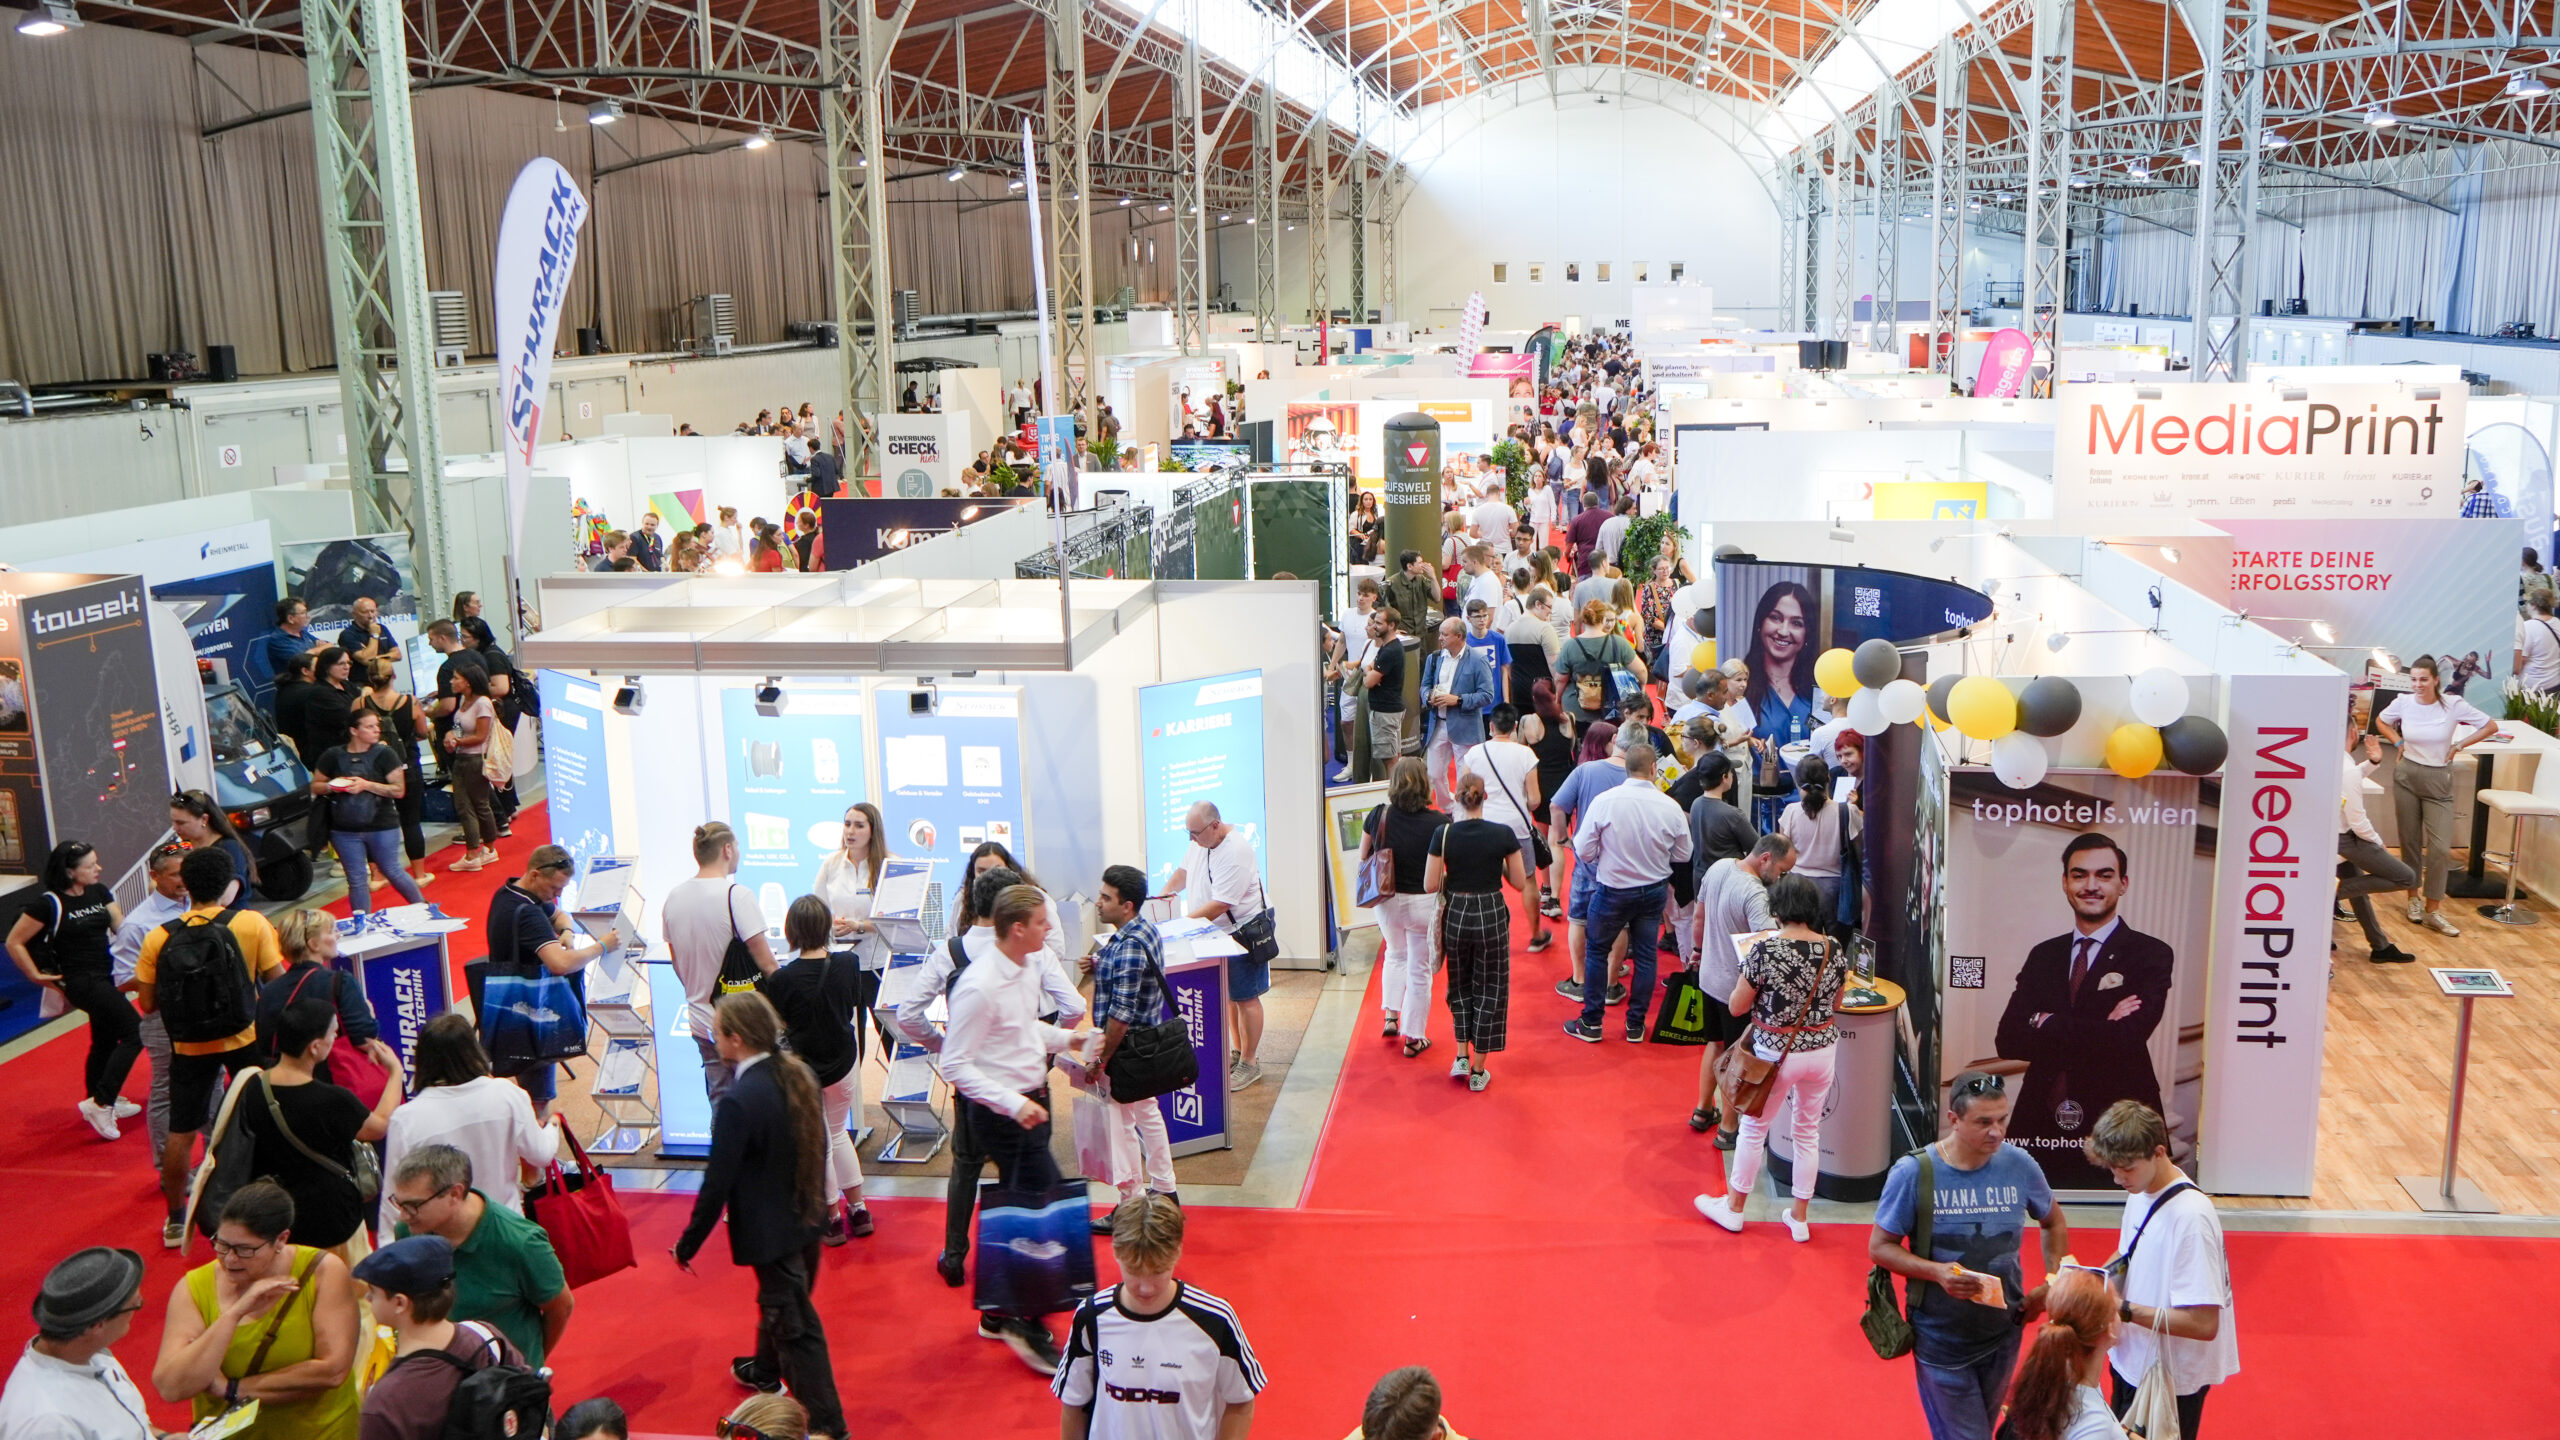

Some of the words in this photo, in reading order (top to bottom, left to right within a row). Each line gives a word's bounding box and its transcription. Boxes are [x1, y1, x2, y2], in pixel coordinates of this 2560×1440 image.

[1615, 319, 1630, 328] ME
[1040, 433, 1060, 443] TIPS
[2088, 403, 2443, 456] MediaPrint
[888, 442, 937, 455] CHECK
[920, 450, 940, 464] hier!
[2275, 472, 2326, 480] KURIER
[2392, 473, 2432, 481] KURIER.at
[2273, 498, 2296, 507] profil
[210, 543, 250, 556] RHEINMETALL
[2311, 551, 2375, 568] DEINE
[32, 591, 139, 635] tousek
[200, 617, 229, 636] IVEN
[1165, 712, 1232, 737] KARRIERE
[257, 759, 295, 778] RHEINMETALL
[1972, 797, 2197, 828] tophotels.wien
[2237, 727, 2308, 1048] MediaPrint
[411, 969, 427, 1026] TECHNIK
[1193, 989, 1204, 1047] TECHNIK
[393, 967, 417, 1094] SCHRACK
[1176, 986, 1196, 1119] SACK
[1986, 1186, 2018, 1206] CLUB
